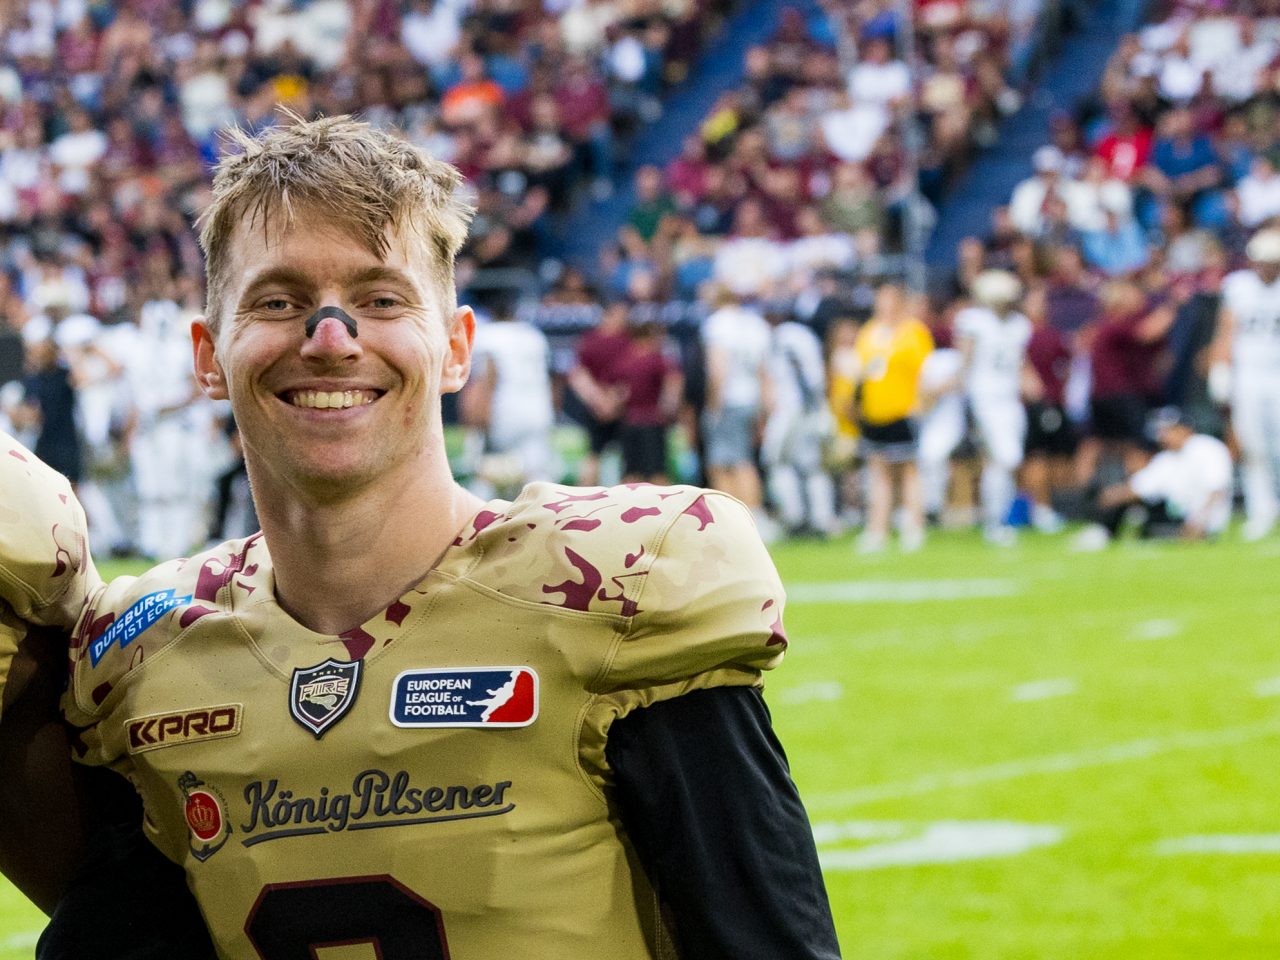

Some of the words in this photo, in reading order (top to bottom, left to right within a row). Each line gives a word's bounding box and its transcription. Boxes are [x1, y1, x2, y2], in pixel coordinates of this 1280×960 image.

[94, 592, 169, 659] DUISBURG
[123, 616, 145, 641] IST
[147, 598, 186, 622] ECHT
[299, 678, 350, 702] FIRE
[405, 691, 451, 703] LEAGUE
[406, 678, 472, 692] EUROPEAN
[404, 704, 467, 716] FOOTBALL
[240, 778, 350, 833] König
[350, 768, 512, 820] Pilsener
